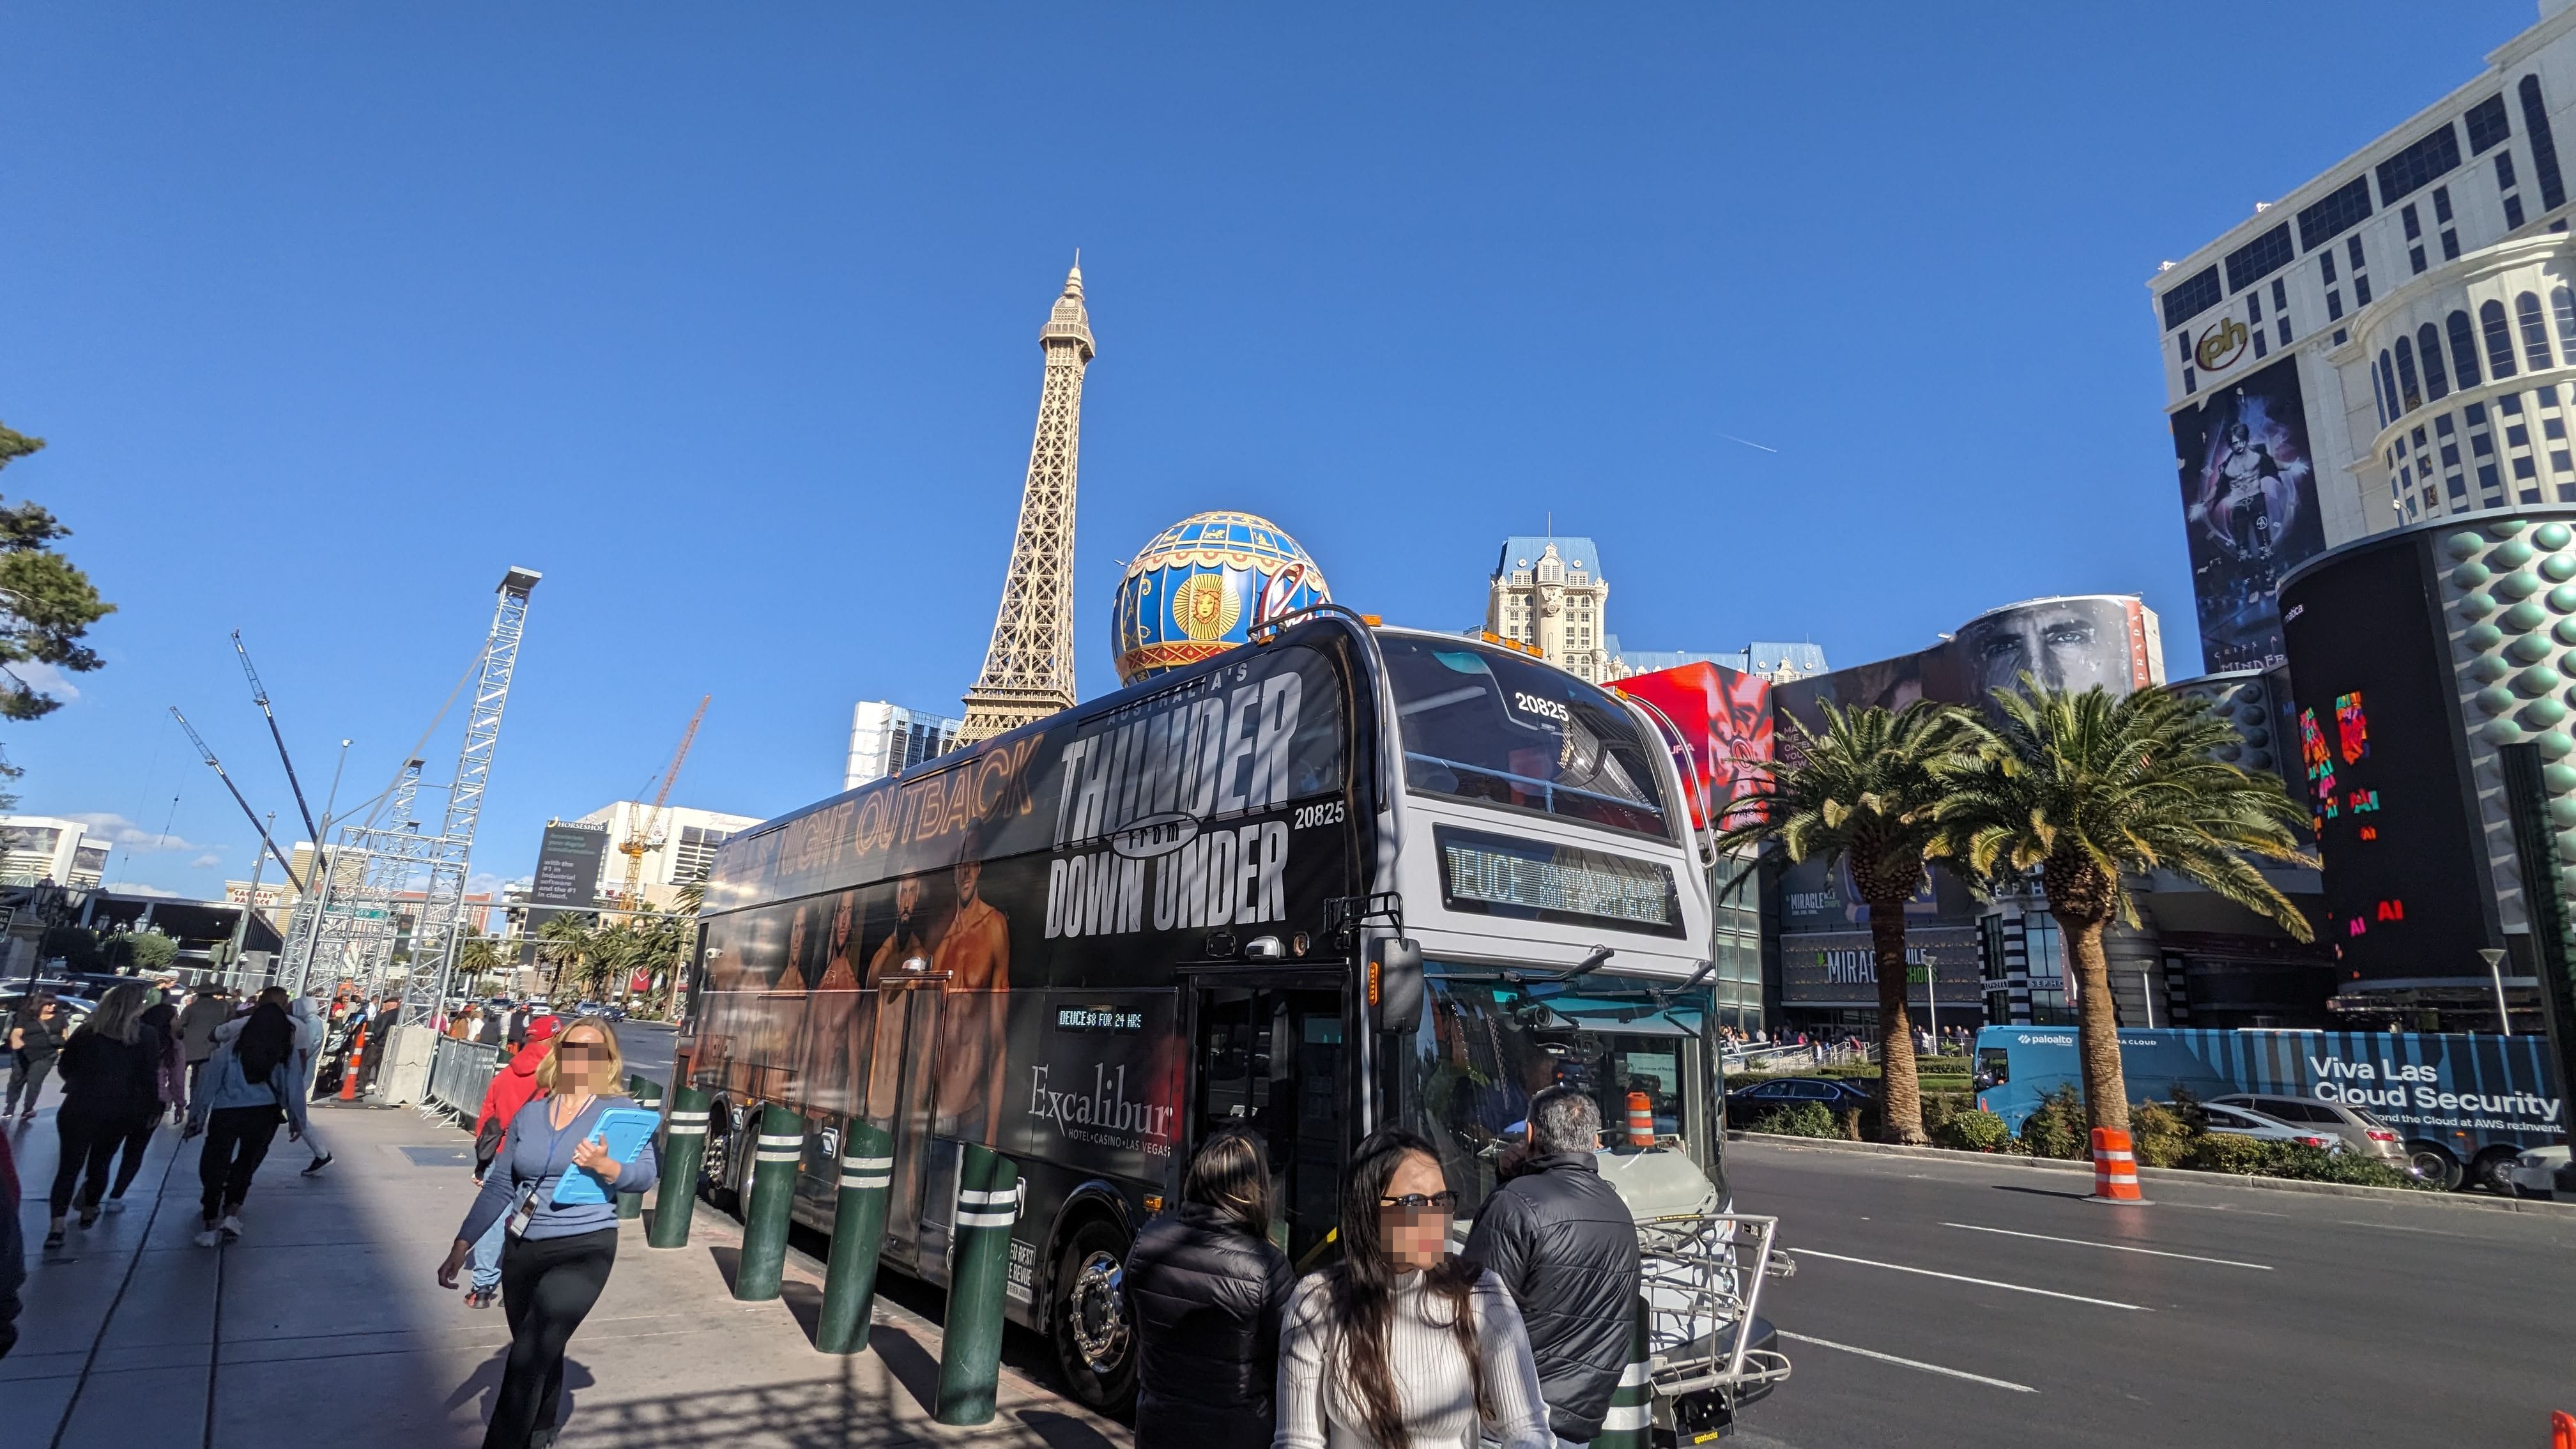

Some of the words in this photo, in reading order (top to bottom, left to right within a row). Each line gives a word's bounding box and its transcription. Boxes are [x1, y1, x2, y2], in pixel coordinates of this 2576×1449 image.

[2131, 615, 2145, 681] PRADA
[2214, 641, 2257, 659] CRISS
[2221, 654, 2286, 673] MINDFR
[1515, 692, 1570, 722] 20825
[1052, 671, 1303, 852] THUNDER
[855, 733, 1045, 855] OUTBACK
[558, 822, 605, 831] HORSESHOE
[1294, 800, 1345, 830] 20825
[1045, 857, 1146, 939] DOWN
[1153, 820, 1289, 932] UNDER
[1791, 892, 1824, 910] MIRACLE
[2377, 899, 2404, 921] AI
[1827, 950, 1878, 983] MIRAC
[1098, 1013, 1113, 1027] FOR
[1115, 1014, 1125, 1028] 24
[2032, 1034, 2073, 1044] paloalto
[2310, 1056, 2375, 1079] Viva
[2383, 1058, 2438, 1083] Las
[1028, 1062, 1174, 1137] Excalibur
[2315, 1081, 2407, 1107] Cloud
[2414, 1085, 2561, 1122] Security
[2401, 1114, 2421, 1123] the
[2425, 1115, 2457, 1127] Cloud
[2460, 1117, 2473, 1127] at
[2474, 1118, 2505, 1129] AWS
[1142, 1141, 1171, 1158] VEGAS
[1018, 1245, 1034, 1267] BEST
[1013, 1263, 1032, 1287] REVUE
